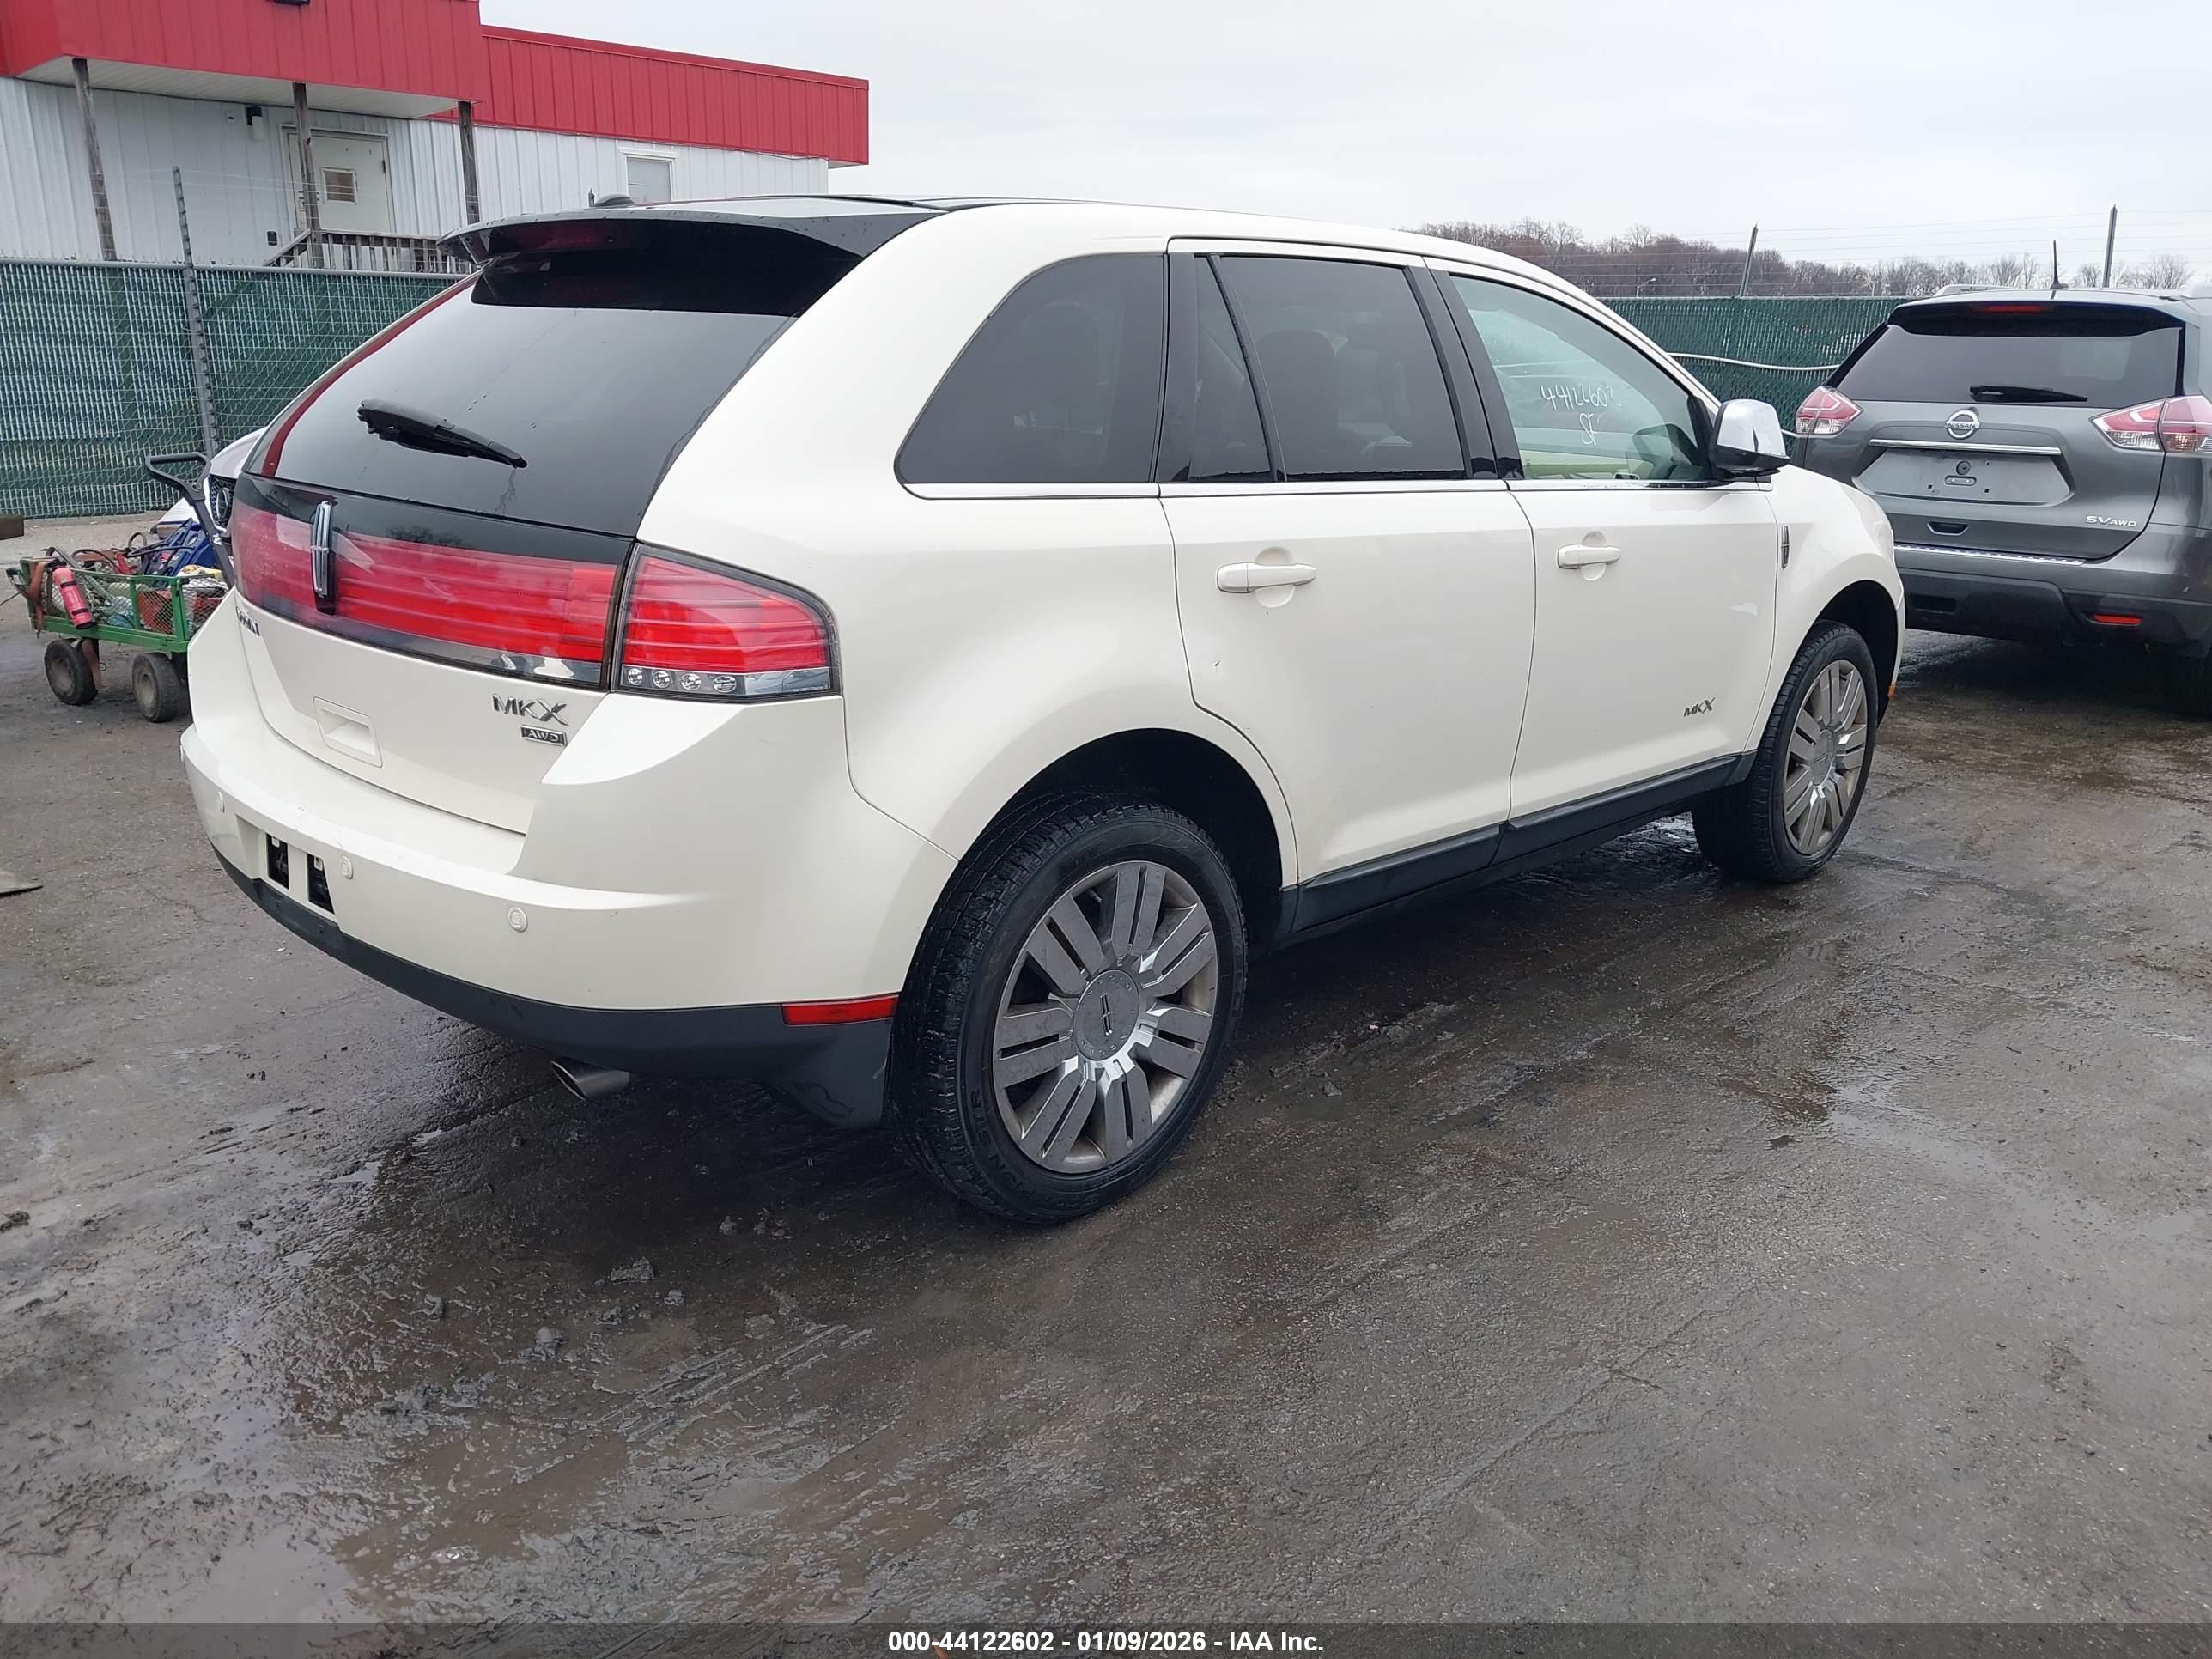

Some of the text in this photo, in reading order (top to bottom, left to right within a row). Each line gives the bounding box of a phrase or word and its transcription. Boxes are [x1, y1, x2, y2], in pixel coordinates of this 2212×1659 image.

[492, 693, 569, 726] MKX
[1683, 696, 1716, 718] MKX
[526, 728, 560, 743] AWD
